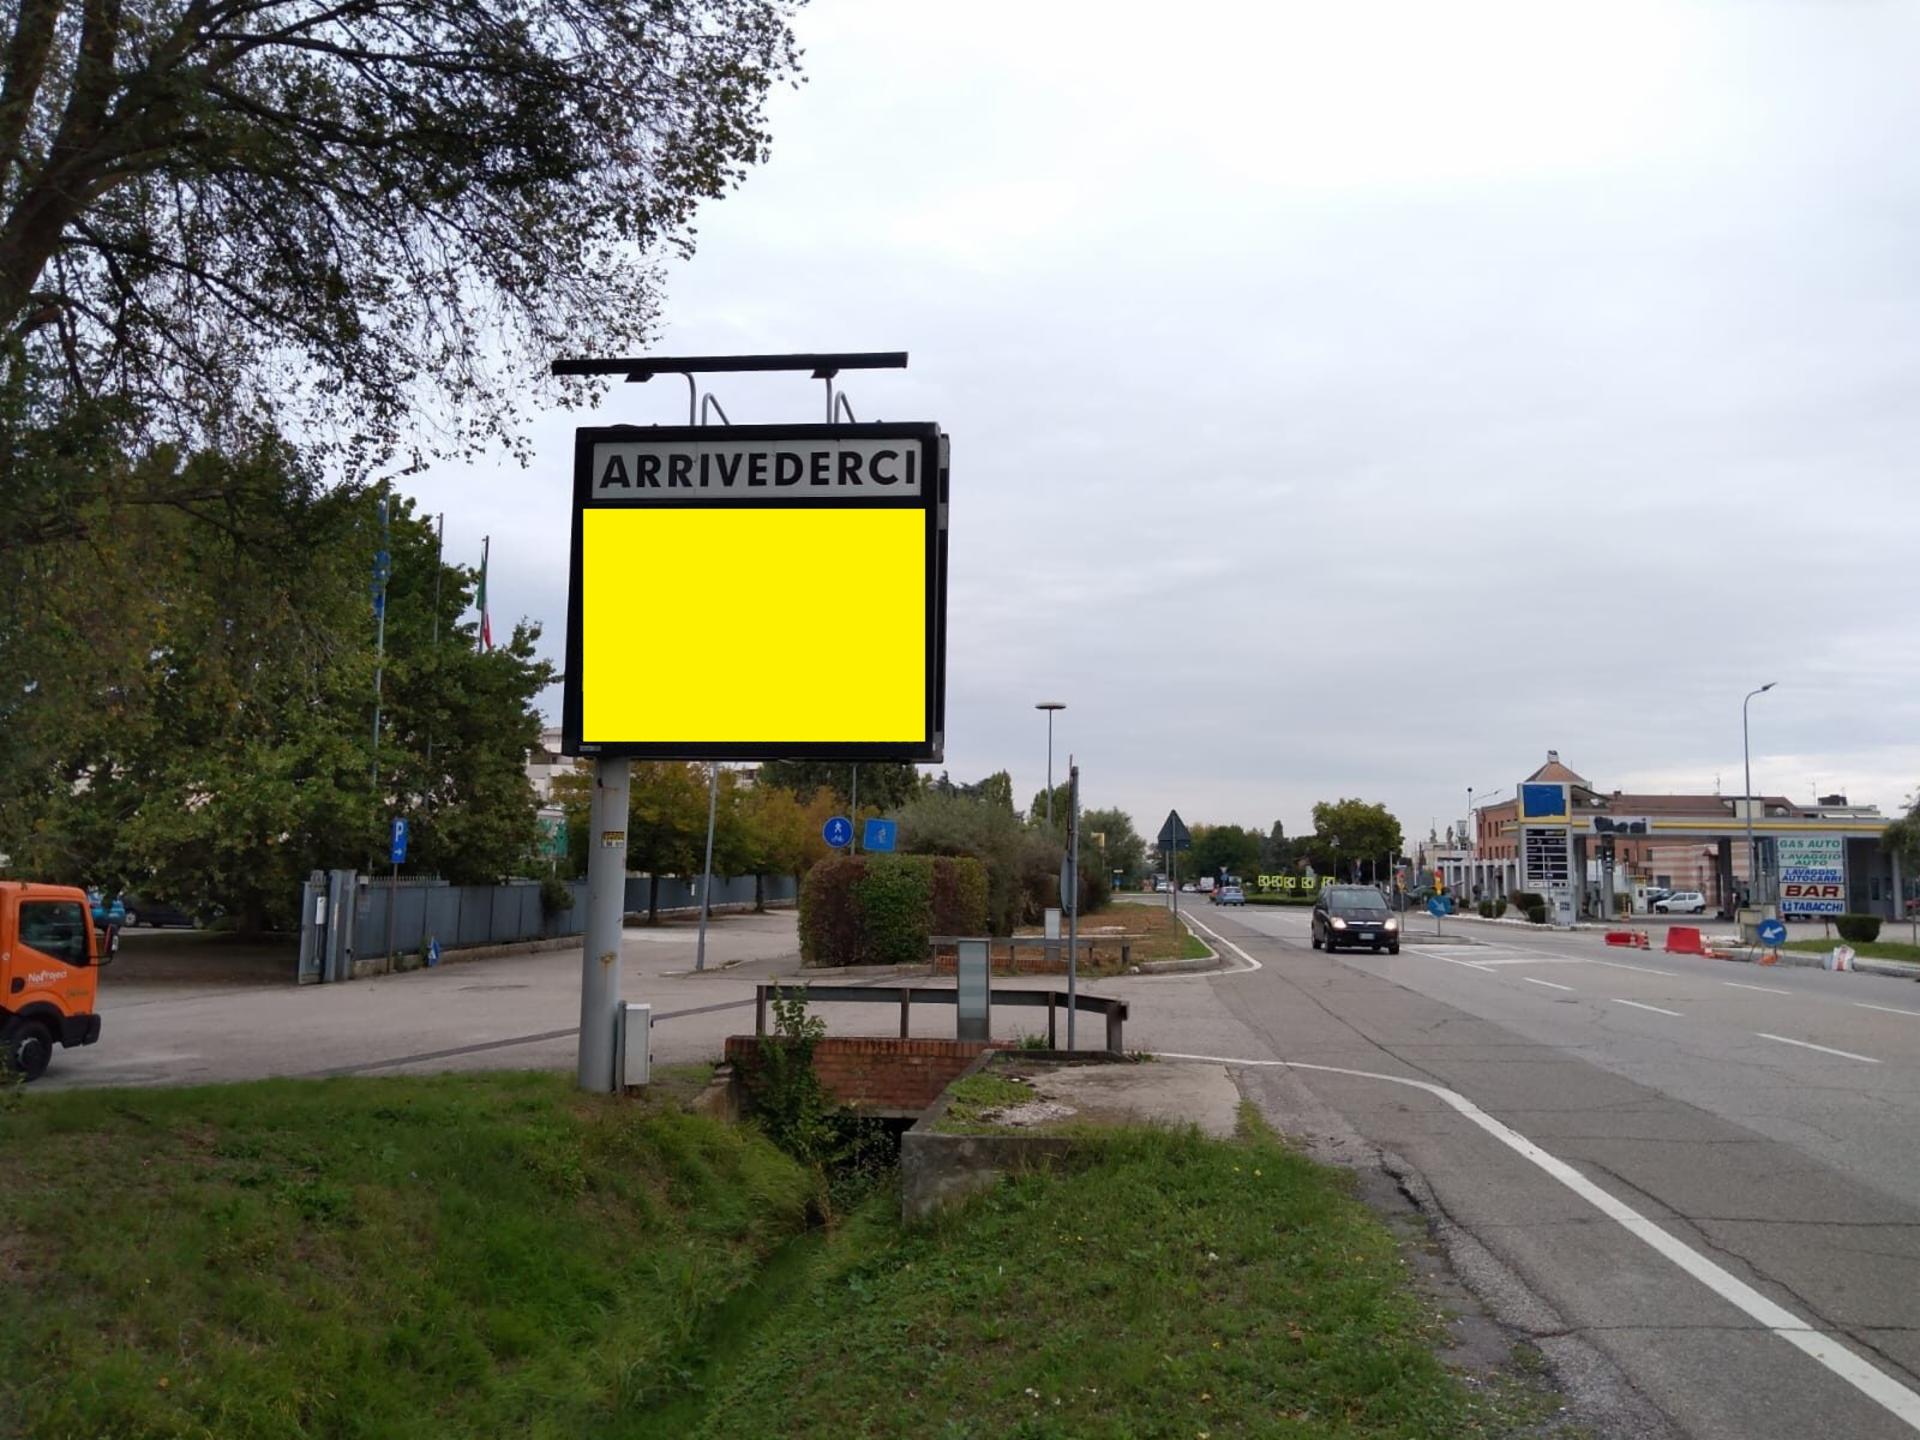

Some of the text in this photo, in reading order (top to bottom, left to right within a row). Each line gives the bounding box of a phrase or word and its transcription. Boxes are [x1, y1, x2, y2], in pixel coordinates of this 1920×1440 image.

[599, 449, 916, 489] ARRIVEDERCI
[395, 821, 404, 843] P
[1780, 839, 1841, 849] GAS AUTO
[1785, 885, 1839, 897] BAR
[1794, 901, 1843, 912] TABACCHI
